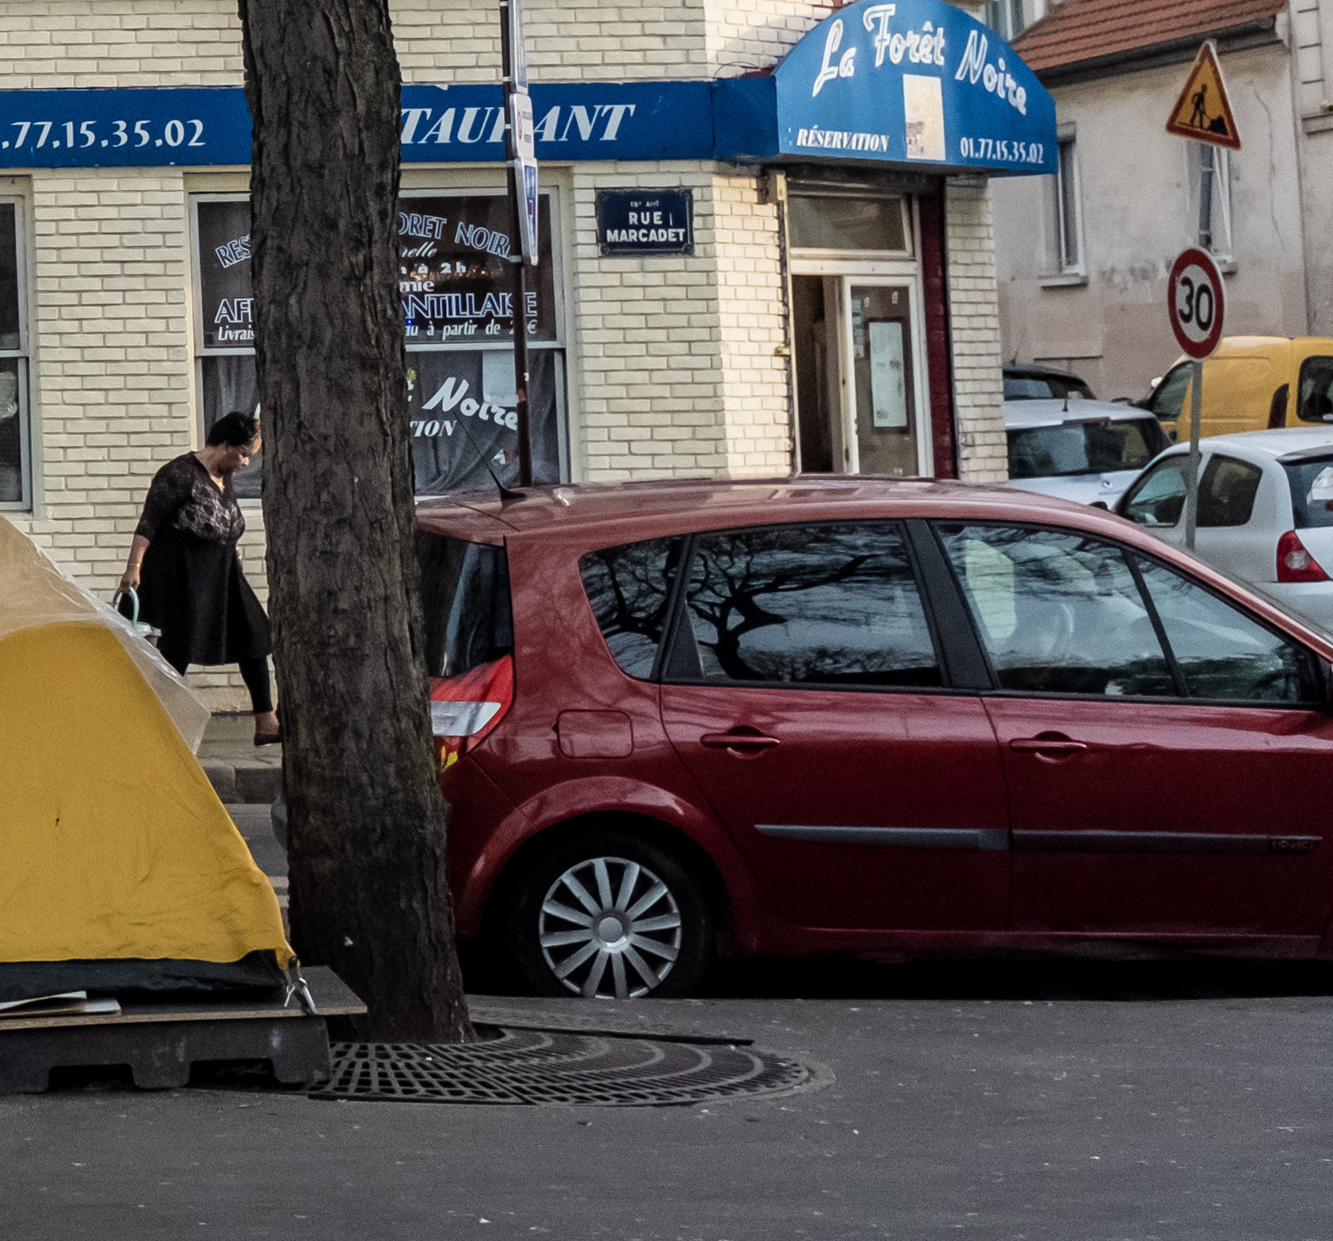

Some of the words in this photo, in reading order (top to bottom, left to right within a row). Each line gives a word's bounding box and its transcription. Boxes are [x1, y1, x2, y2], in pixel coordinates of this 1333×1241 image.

[812, 18, 857, 98] La
[862, 3, 945, 67] Forêt
[955, 29, 1027, 116] Noire
[796, 125, 890, 152] RÉSERVATION
[959, 136, 1045, 164] 01.77.15.35.02
[628, 211, 663, 225] RUE
[606, 228, 686, 243] MARCADET
[440, 262, 451, 274] 2
[455, 261, 466, 273] h
[1178, 276, 1213, 332] 30
[427, 322, 435, 337] à
[442, 320, 478, 341] partir
[485, 318, 501, 335] de
